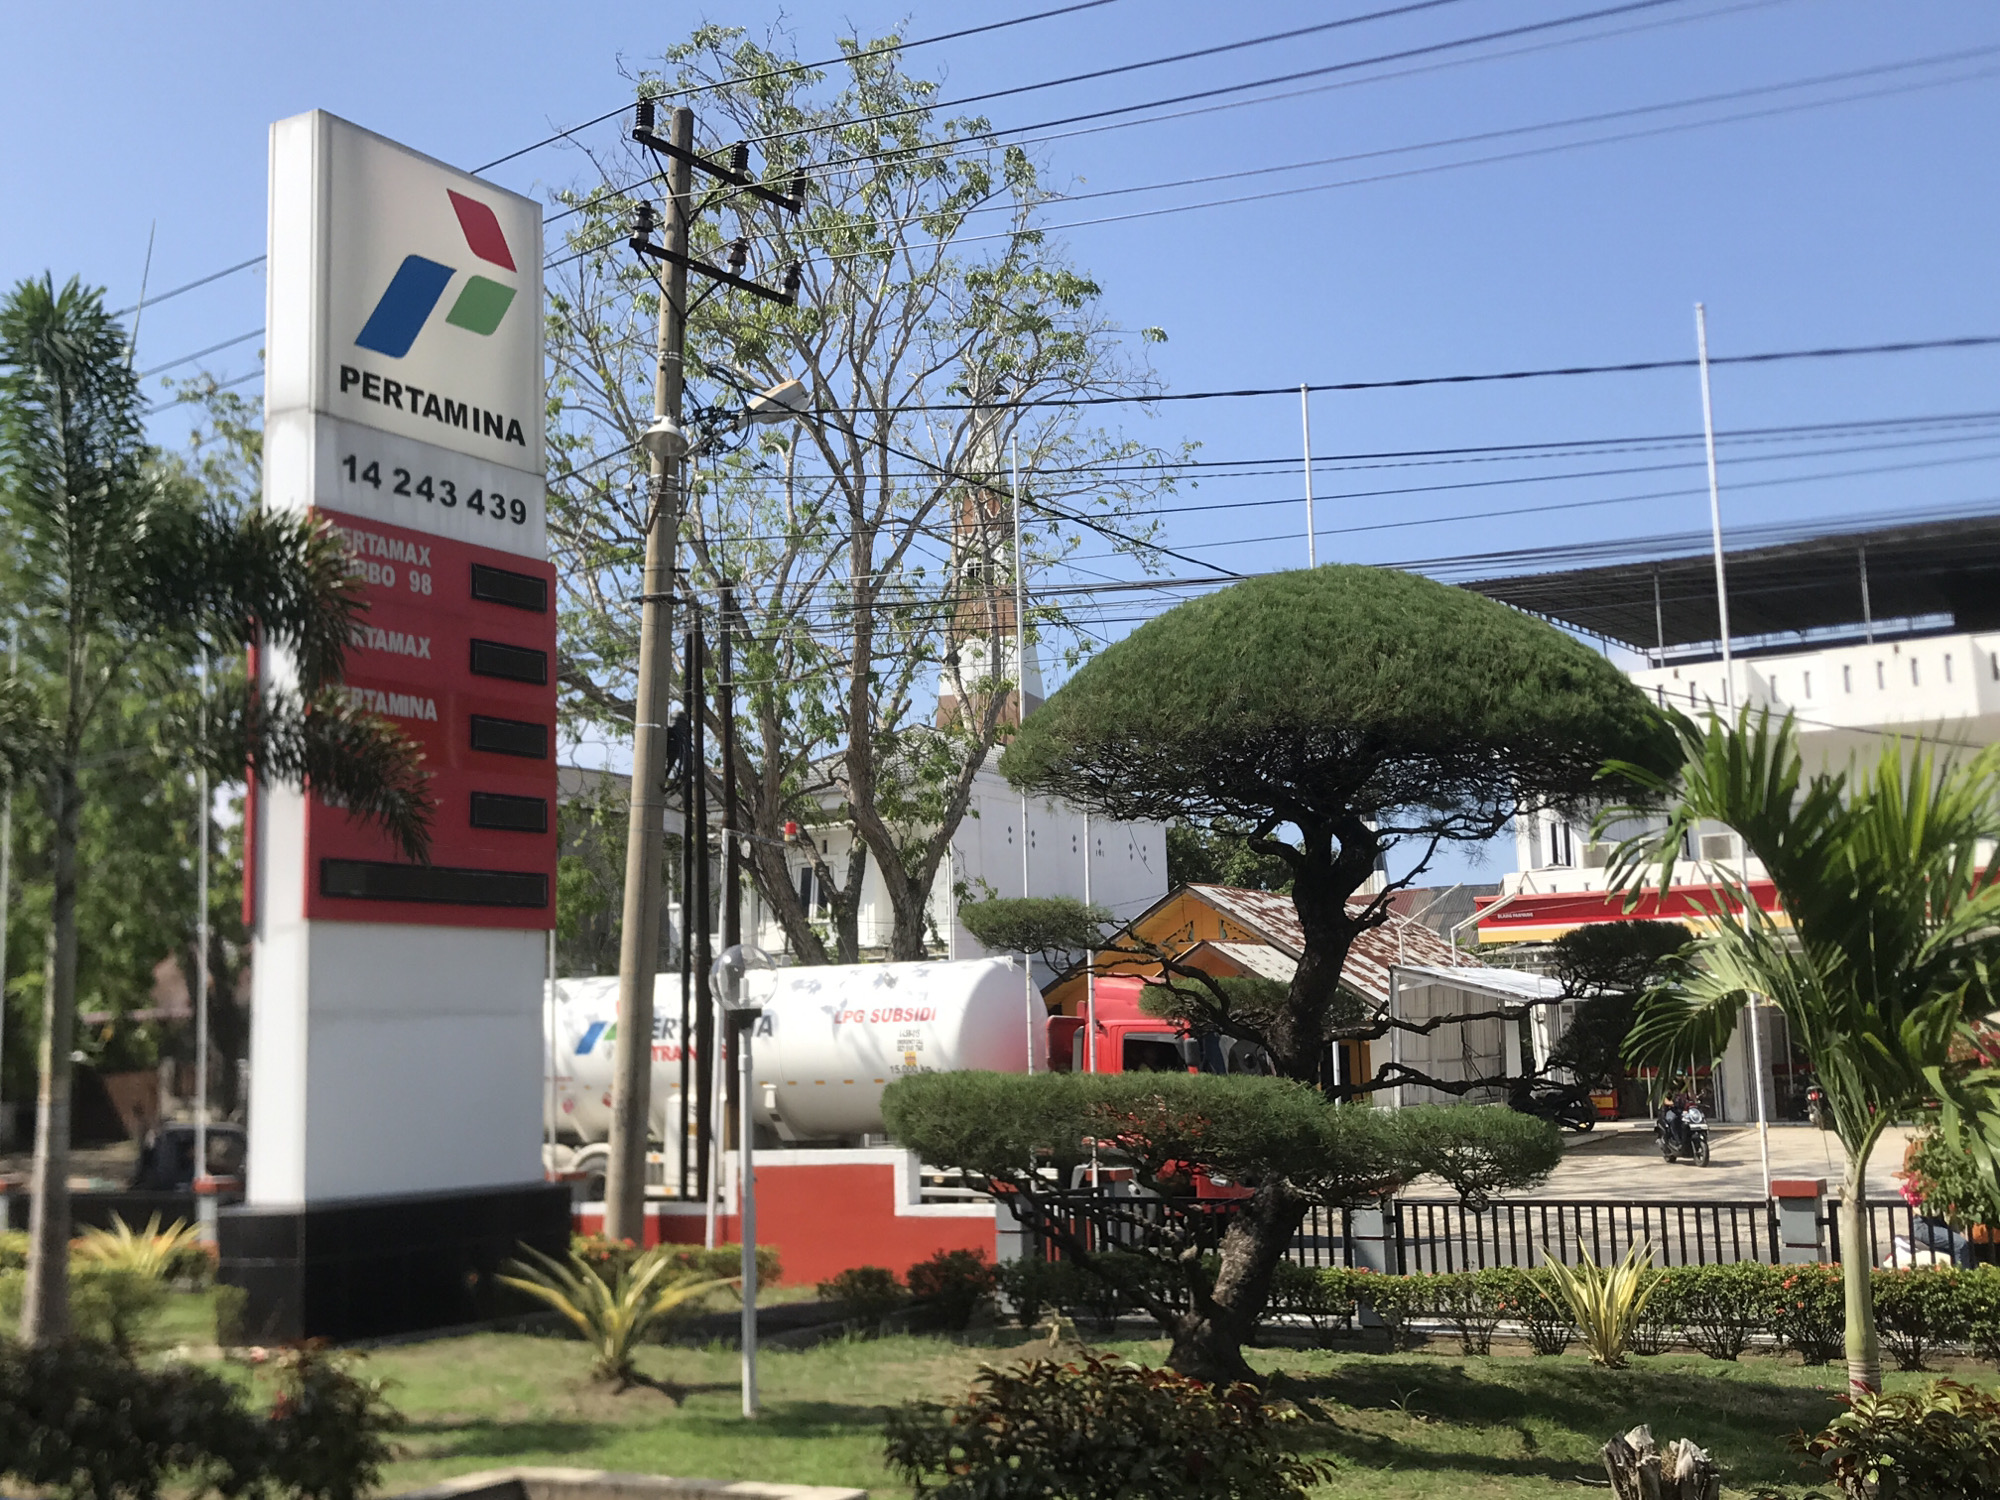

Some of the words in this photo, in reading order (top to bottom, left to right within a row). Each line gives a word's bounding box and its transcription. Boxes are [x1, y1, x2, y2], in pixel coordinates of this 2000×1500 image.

[340, 365, 526, 447] PERTAMINA
[342, 454, 382, 490] 14
[393, 468, 458, 507] 243
[466, 489, 527, 525] 439
[409, 570, 433, 596] 98
[834, 1009, 865, 1024] LPG
[870, 1007, 937, 1023] SUBSIDI
